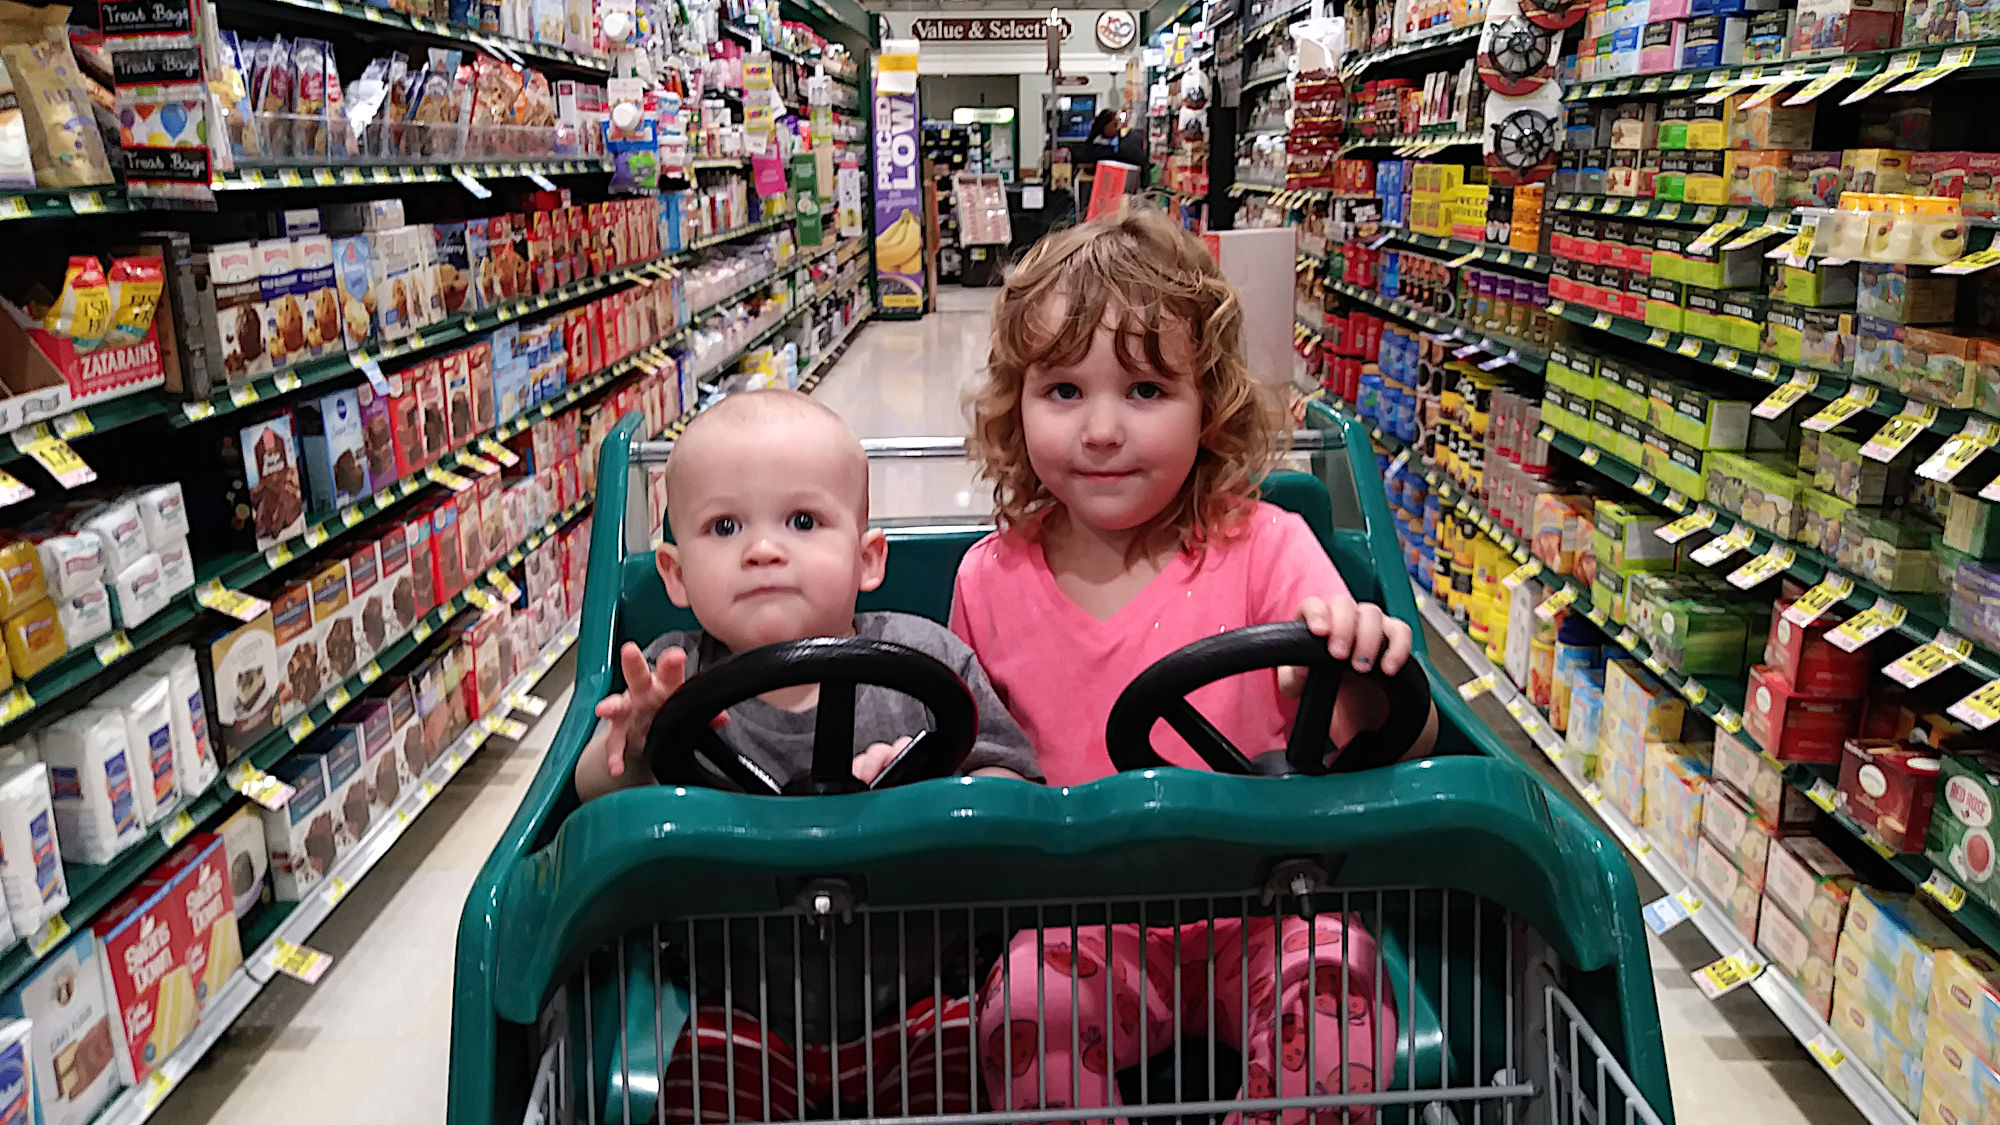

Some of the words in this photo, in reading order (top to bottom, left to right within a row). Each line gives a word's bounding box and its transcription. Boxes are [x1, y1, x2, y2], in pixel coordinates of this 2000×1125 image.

[103, 4, 146, 24] Treat
[152, 2, 189, 28] Bags
[916, 20, 964, 39] Value
[968, 20, 984, 39] &
[989, 19, 1068, 39] Selectin
[114, 55, 155, 75] Treat
[876, 97, 893, 190] PRICED
[892, 97, 916, 190] LOW
[124, 151, 165, 169] Treat
[170, 152, 206, 178] Bags
[1950, 781, 1966, 803] RED
[1967, 792, 1987, 818] ROSE
